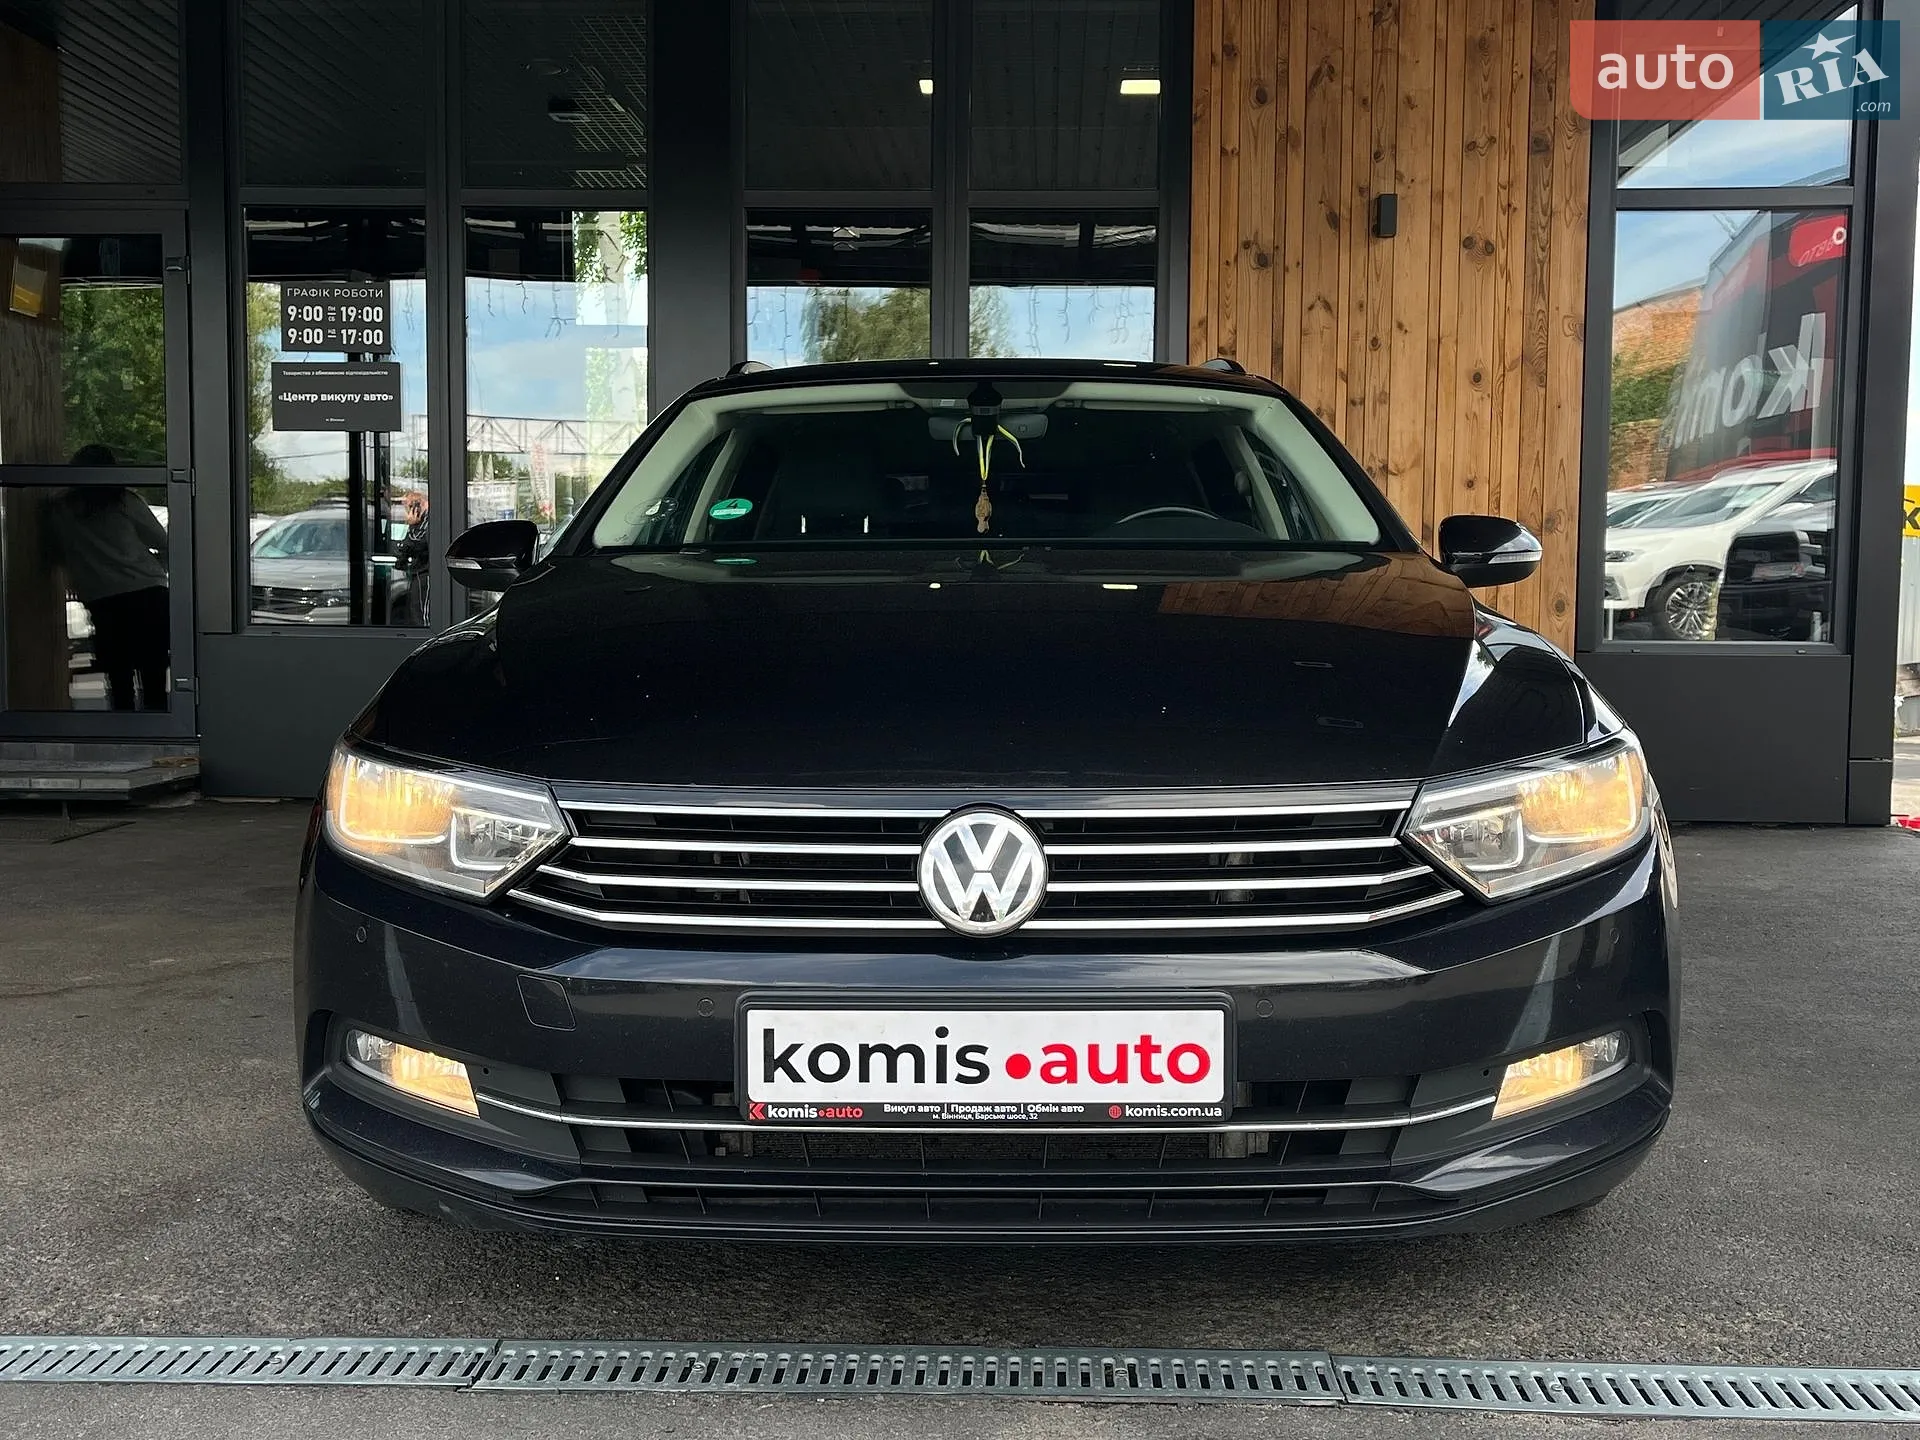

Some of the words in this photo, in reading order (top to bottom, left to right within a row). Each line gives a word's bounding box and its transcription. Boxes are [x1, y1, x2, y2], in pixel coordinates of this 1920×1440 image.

[287, 288, 330, 298] ГРАФІК
[334, 288, 383, 298] РОБОТИ
[287, 305, 323, 322] 9:00
[340, 306, 383, 323] 19:00
[287, 328, 323, 344] 9:00
[340, 329, 383, 345] 17:00
[278, 392, 318, 403] «Центр
[320, 393, 361, 403] викупу
[363, 393, 394, 401] авто»
[763, 1026, 990, 1085] komis
[883, 1104, 916, 1114] Викуп
[917, 1105, 941, 1113] авто
[950, 1104, 992, 1114] Продаж
[994, 1105, 1018, 1113] авто
[1027, 1104, 1059, 1113] Обмін
[1060, 1105, 1085, 1113] авто
[1125, 1104, 1222, 1117] komis.com.ua
